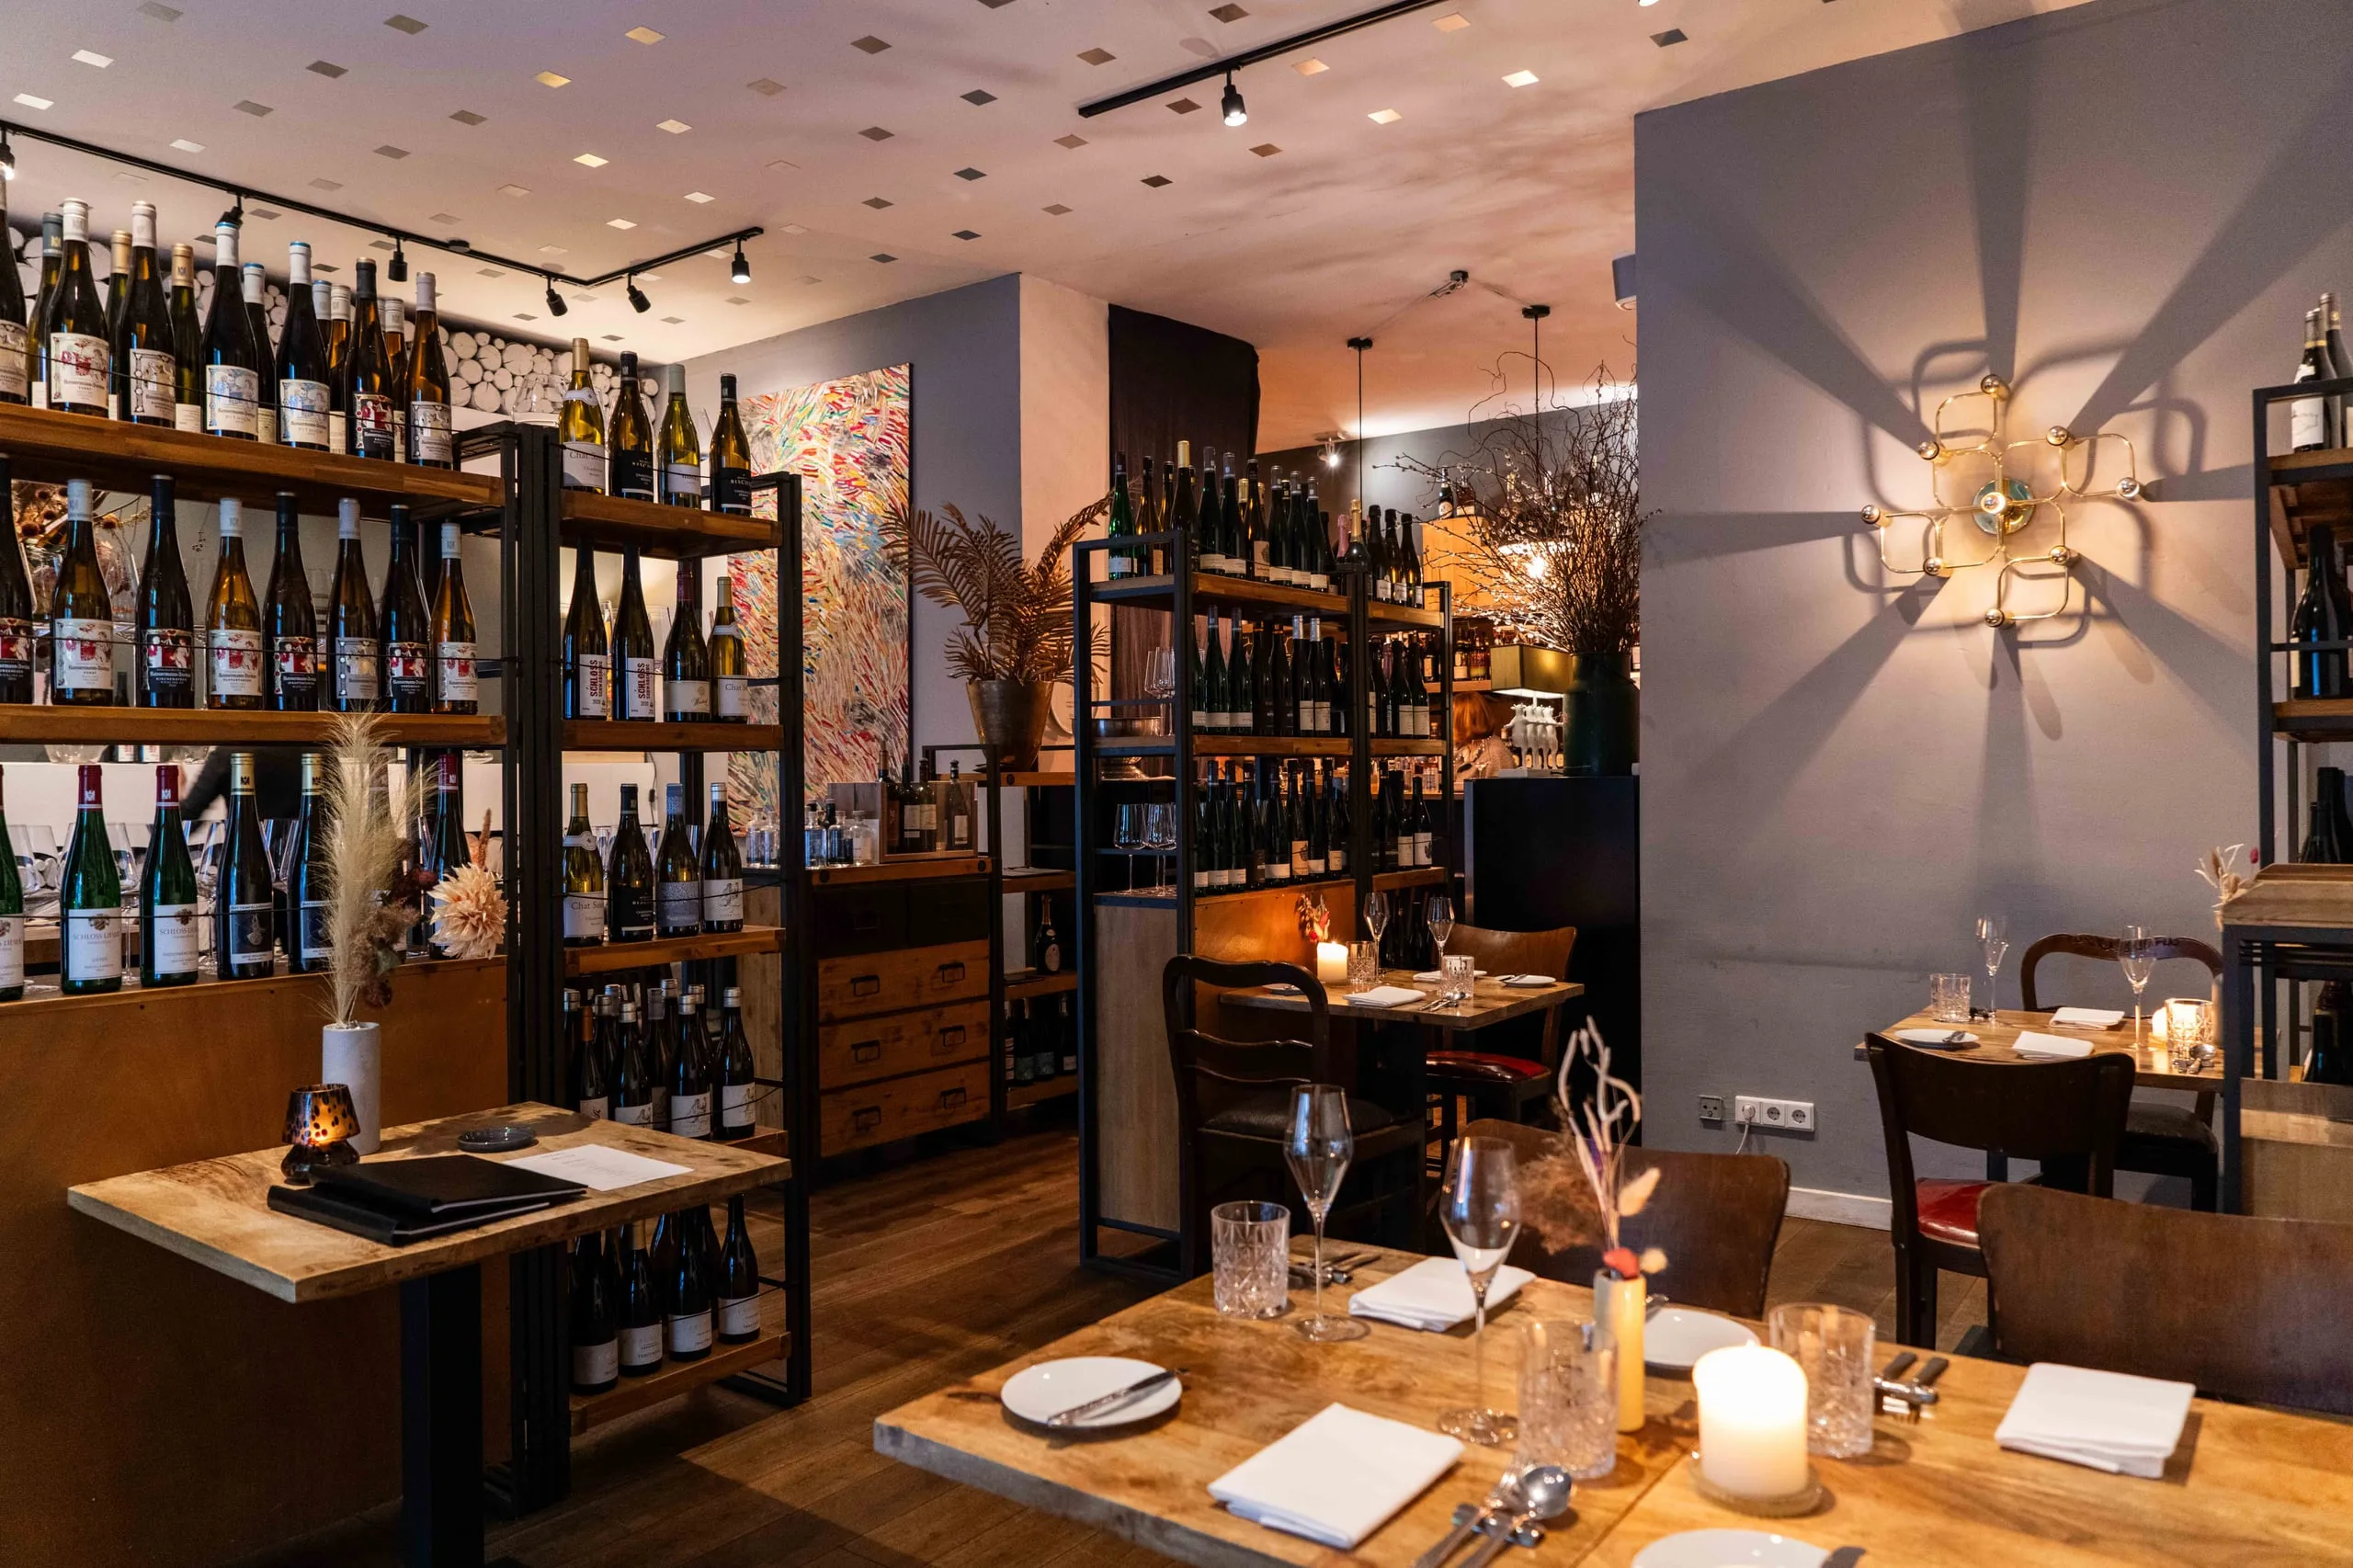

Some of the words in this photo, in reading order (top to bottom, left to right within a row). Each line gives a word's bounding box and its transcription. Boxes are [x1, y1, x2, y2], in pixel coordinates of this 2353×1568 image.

[589, 660, 598, 697] SCHLOSS
[637, 663, 646, 699] SCHLOSS
[571, 902, 591, 910] Chat
